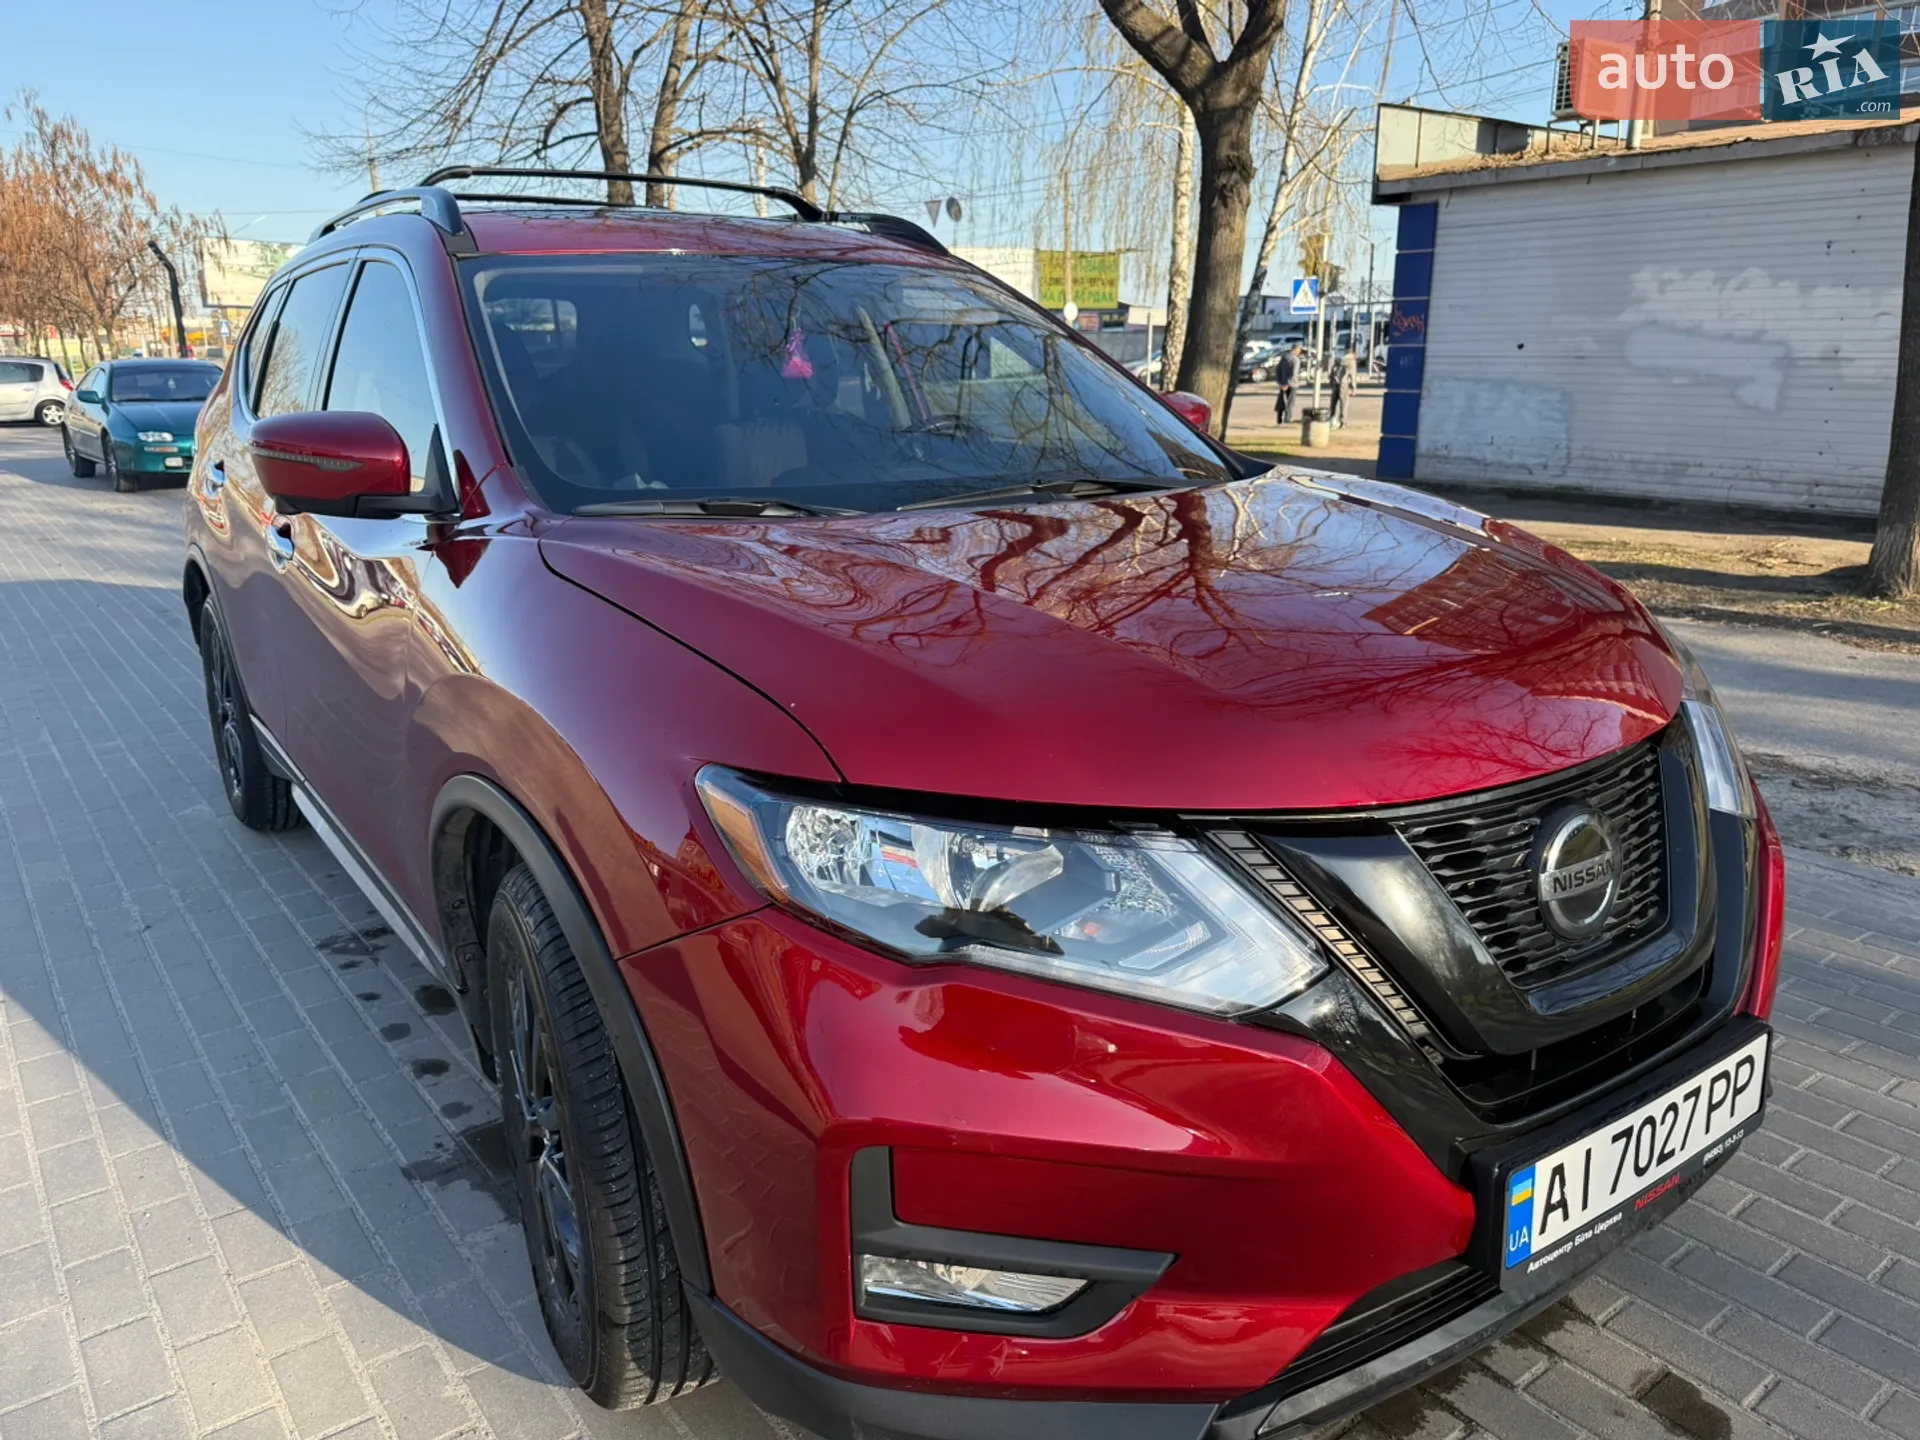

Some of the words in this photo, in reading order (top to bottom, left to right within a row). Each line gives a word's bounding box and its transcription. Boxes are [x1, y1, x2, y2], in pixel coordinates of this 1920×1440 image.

[1553, 857, 1615, 894] NISSAN
[1538, 1147, 1592, 1236] AI
[1609, 1084, 1702, 1196] 7027
[1704, 1053, 1755, 1135] PP
[1634, 1172, 1681, 1212] NISSAN
[1509, 1225, 1530, 1252] UA
[1526, 1241, 1573, 1275] Автоцентр
